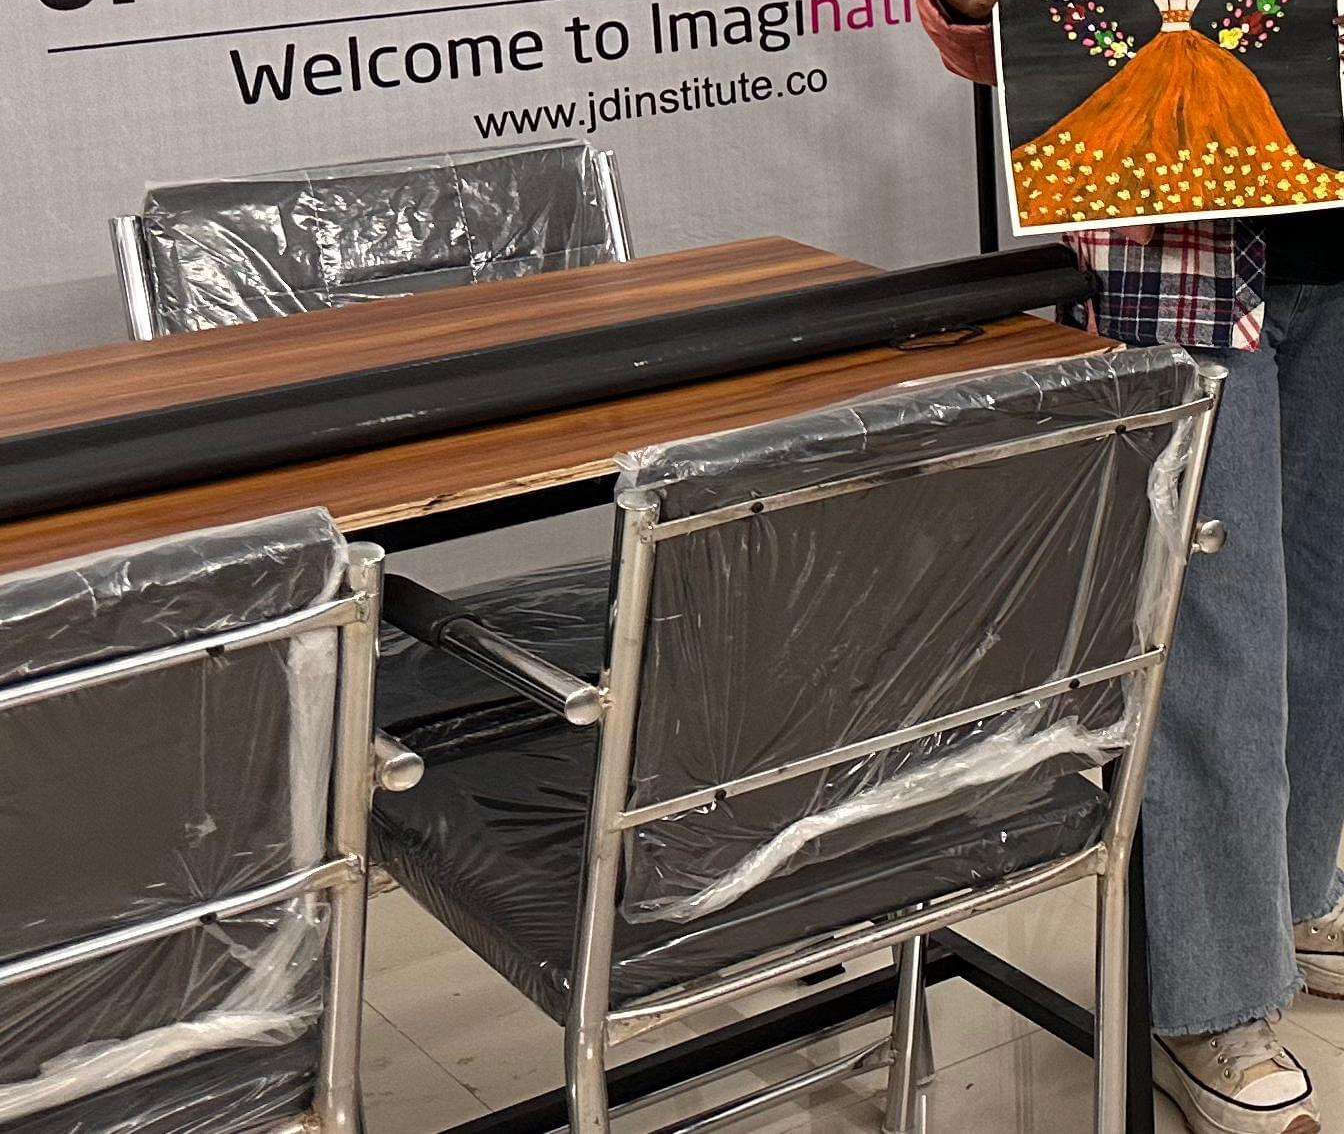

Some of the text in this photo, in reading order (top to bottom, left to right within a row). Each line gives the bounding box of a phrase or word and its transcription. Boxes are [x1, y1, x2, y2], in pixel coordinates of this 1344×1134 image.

[230, 30, 545, 105] Welcome
[564, 14, 630, 65] to
[474, 65, 828, 140] www.jdinstitute.co
